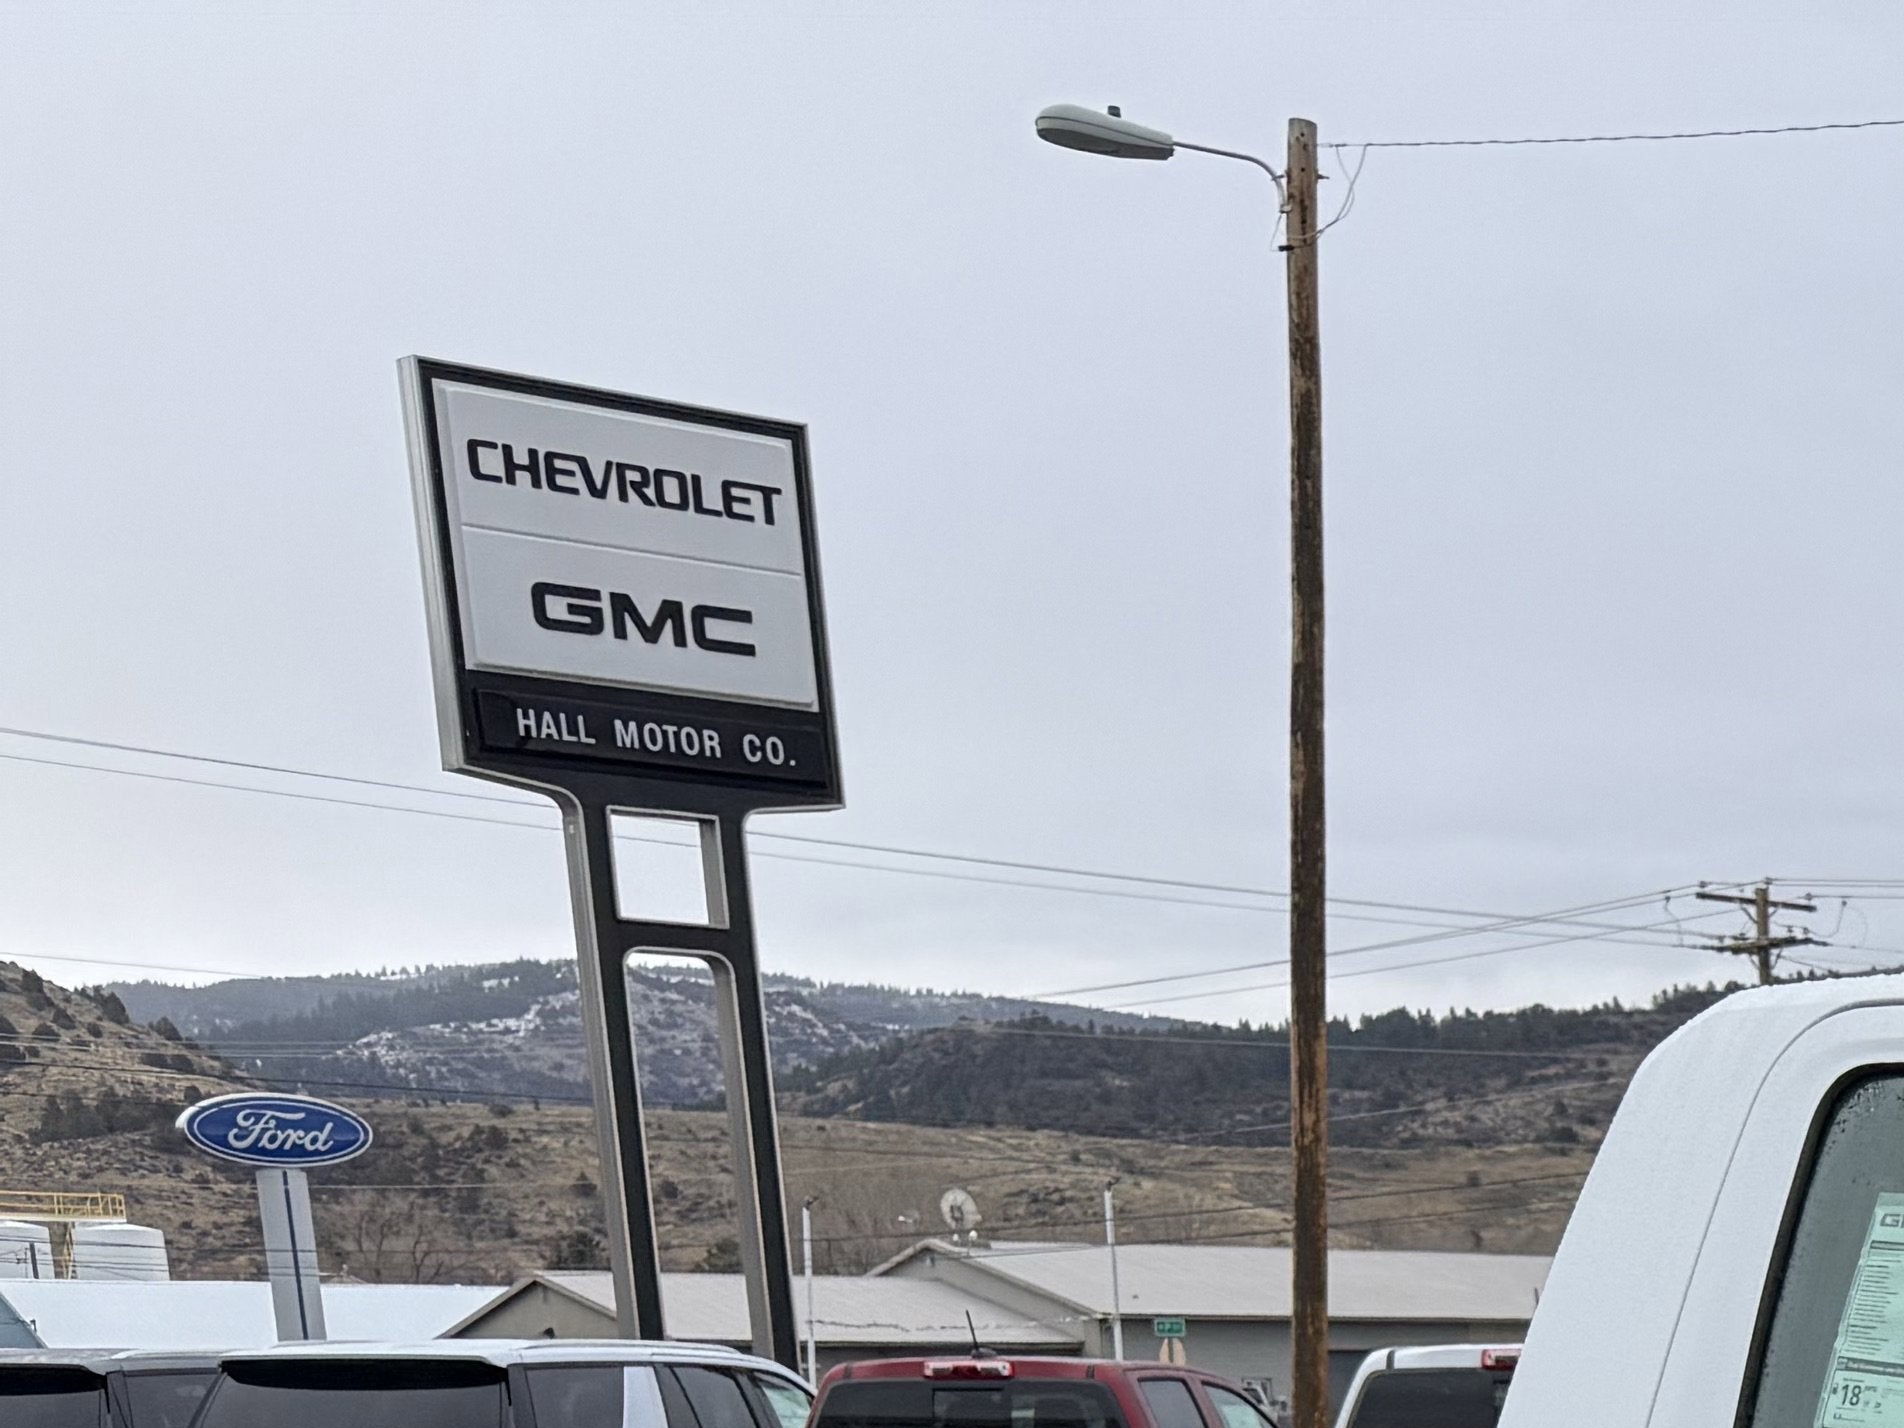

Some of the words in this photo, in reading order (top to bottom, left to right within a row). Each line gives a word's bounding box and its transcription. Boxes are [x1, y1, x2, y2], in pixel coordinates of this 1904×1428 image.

[466, 438, 782, 526] CHEVROLET
[531, 581, 757, 657] GMC
[516, 707, 597, 745] HALL
[615, 718, 722, 758] MOTOR
[742, 733, 797, 767] CO.
[227, 1108, 334, 1152] Ford
[1840, 1384, 1863, 1407] 18
